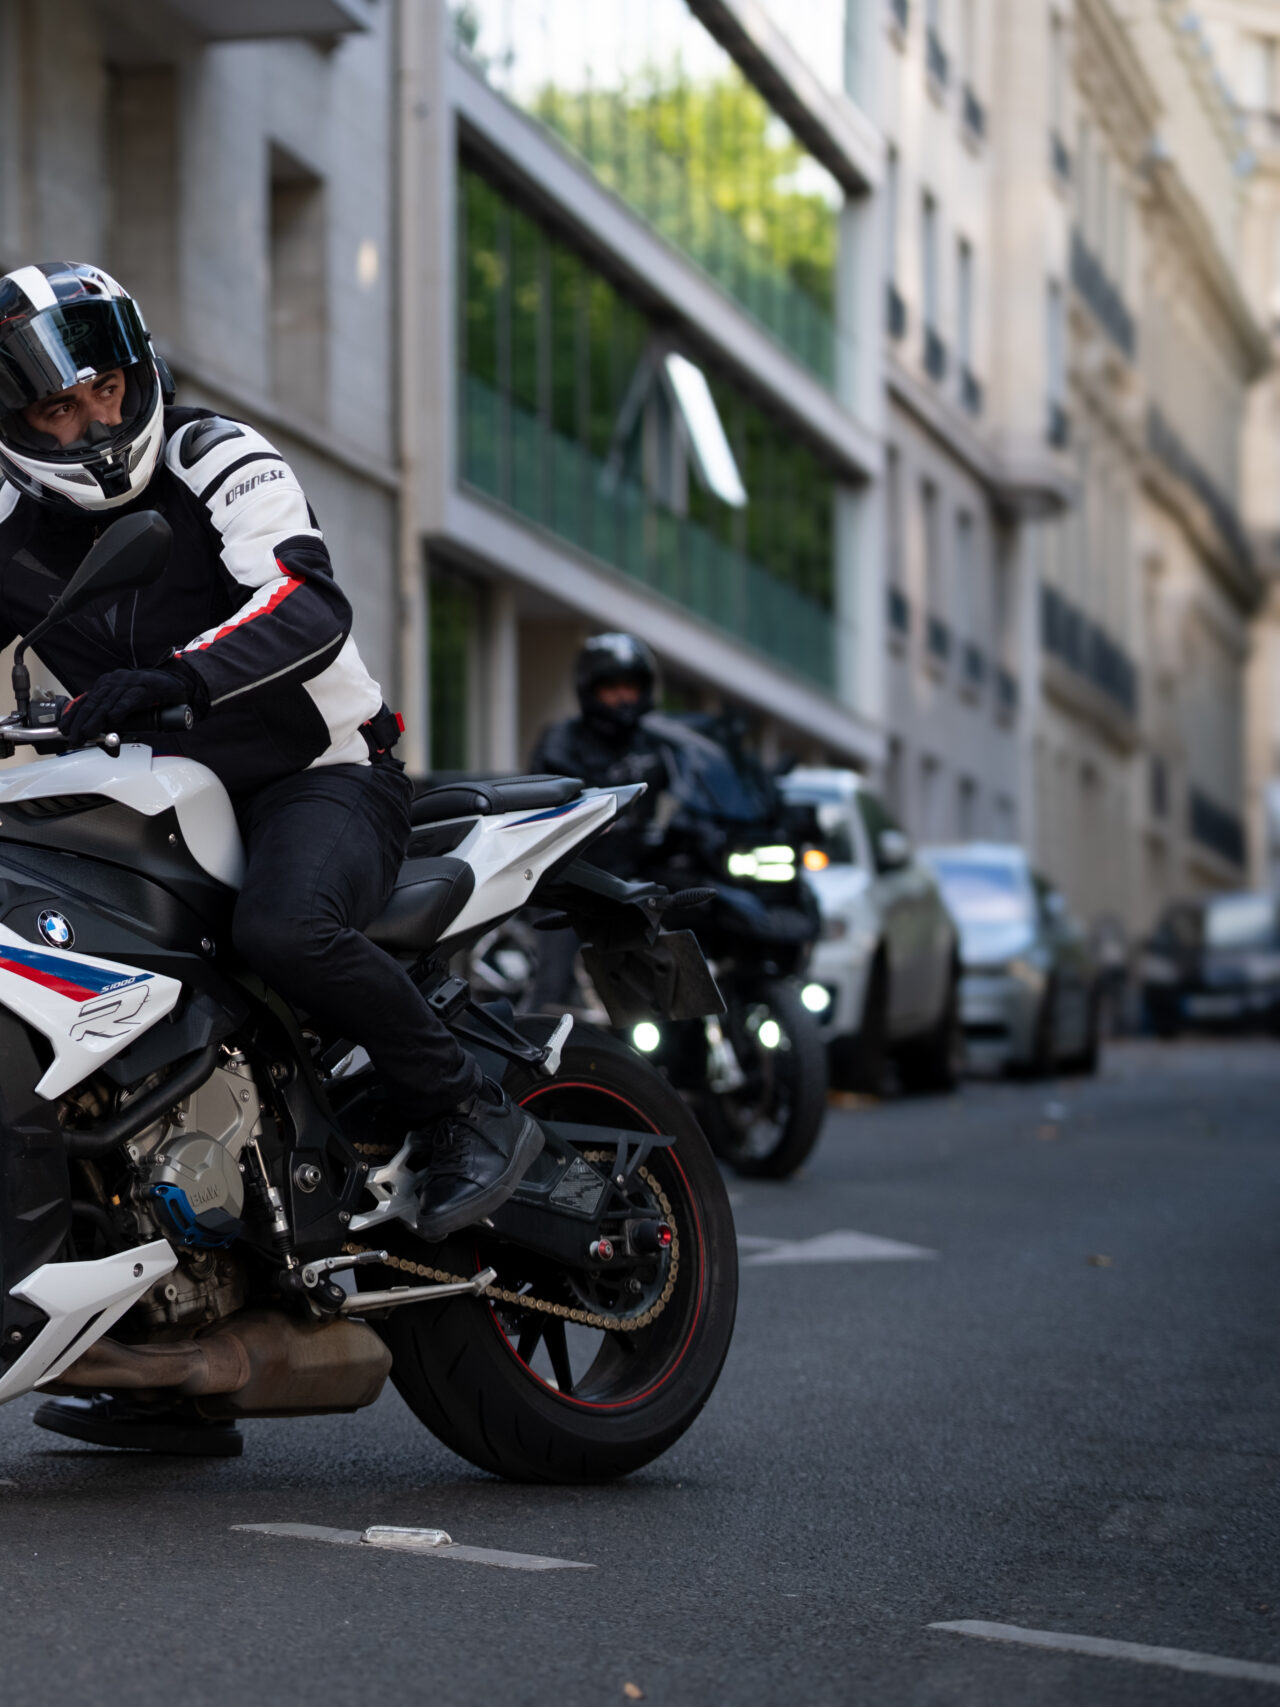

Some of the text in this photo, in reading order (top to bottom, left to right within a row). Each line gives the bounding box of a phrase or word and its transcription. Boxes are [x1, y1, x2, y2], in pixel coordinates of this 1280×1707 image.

[225, 469, 286, 507] DAINESE
[100, 977, 136, 994] S1000
[190, 1184, 218, 1207] BMW
